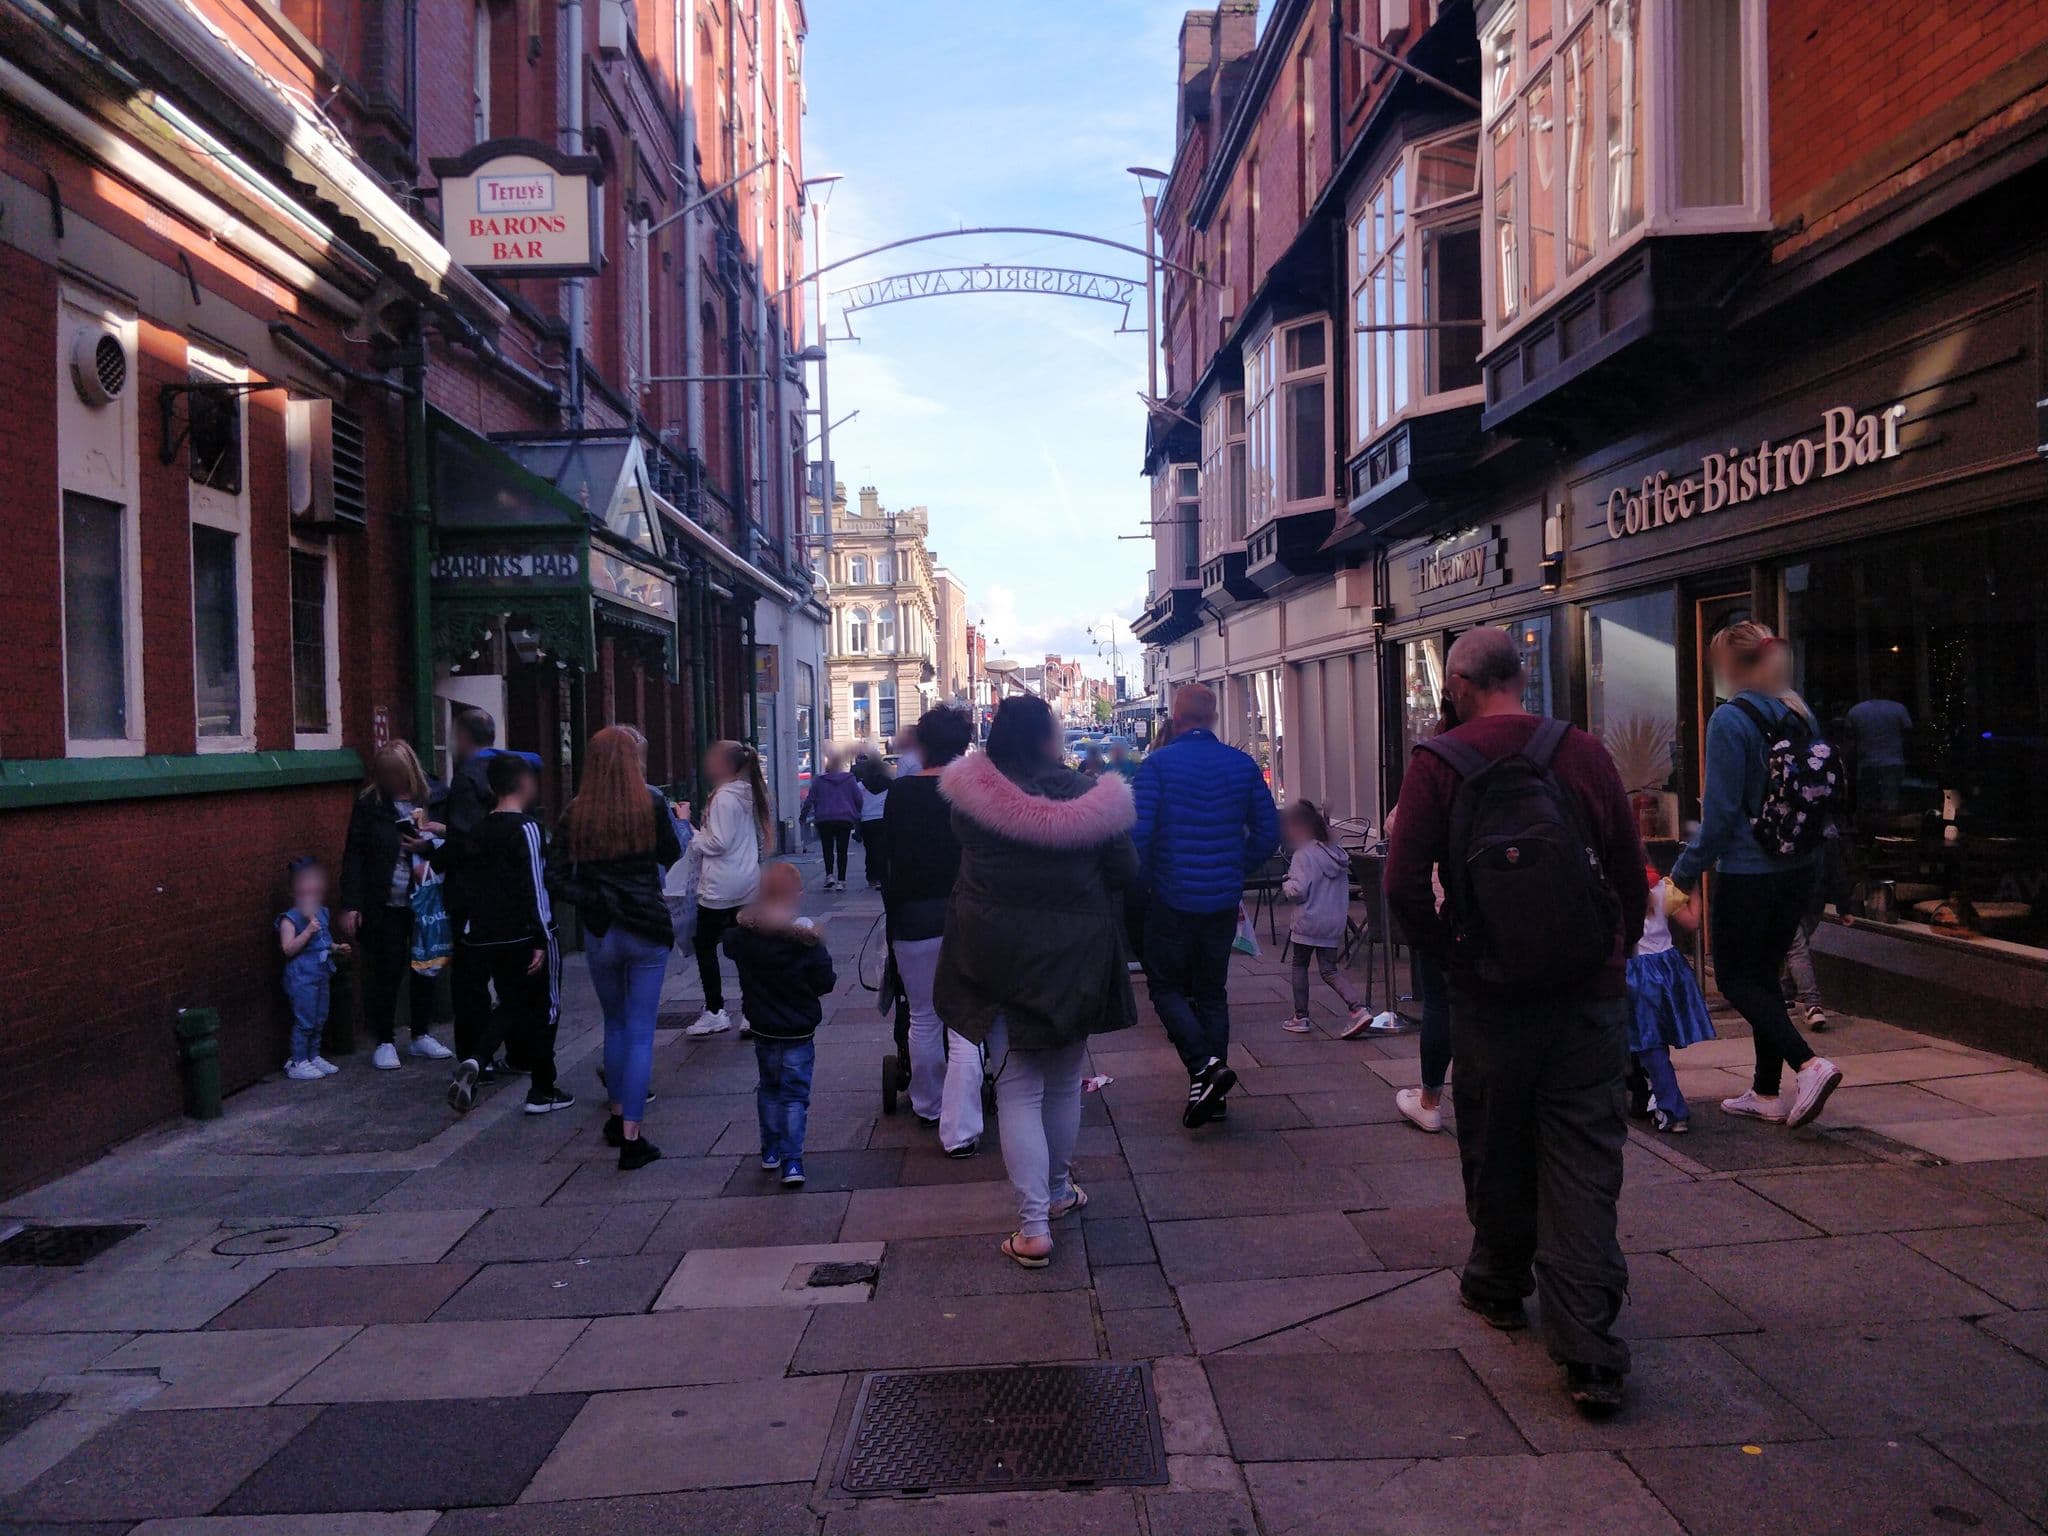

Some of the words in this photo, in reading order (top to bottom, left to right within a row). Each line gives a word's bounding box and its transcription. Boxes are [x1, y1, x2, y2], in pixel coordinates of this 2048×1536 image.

[488, 182, 544, 200] TETLEY'S
[469, 216, 566, 237] BARONS
[493, 241, 544, 260] BAR
[532, 554, 575, 577] BAR
[1418, 544, 1487, 591] Hideaway
